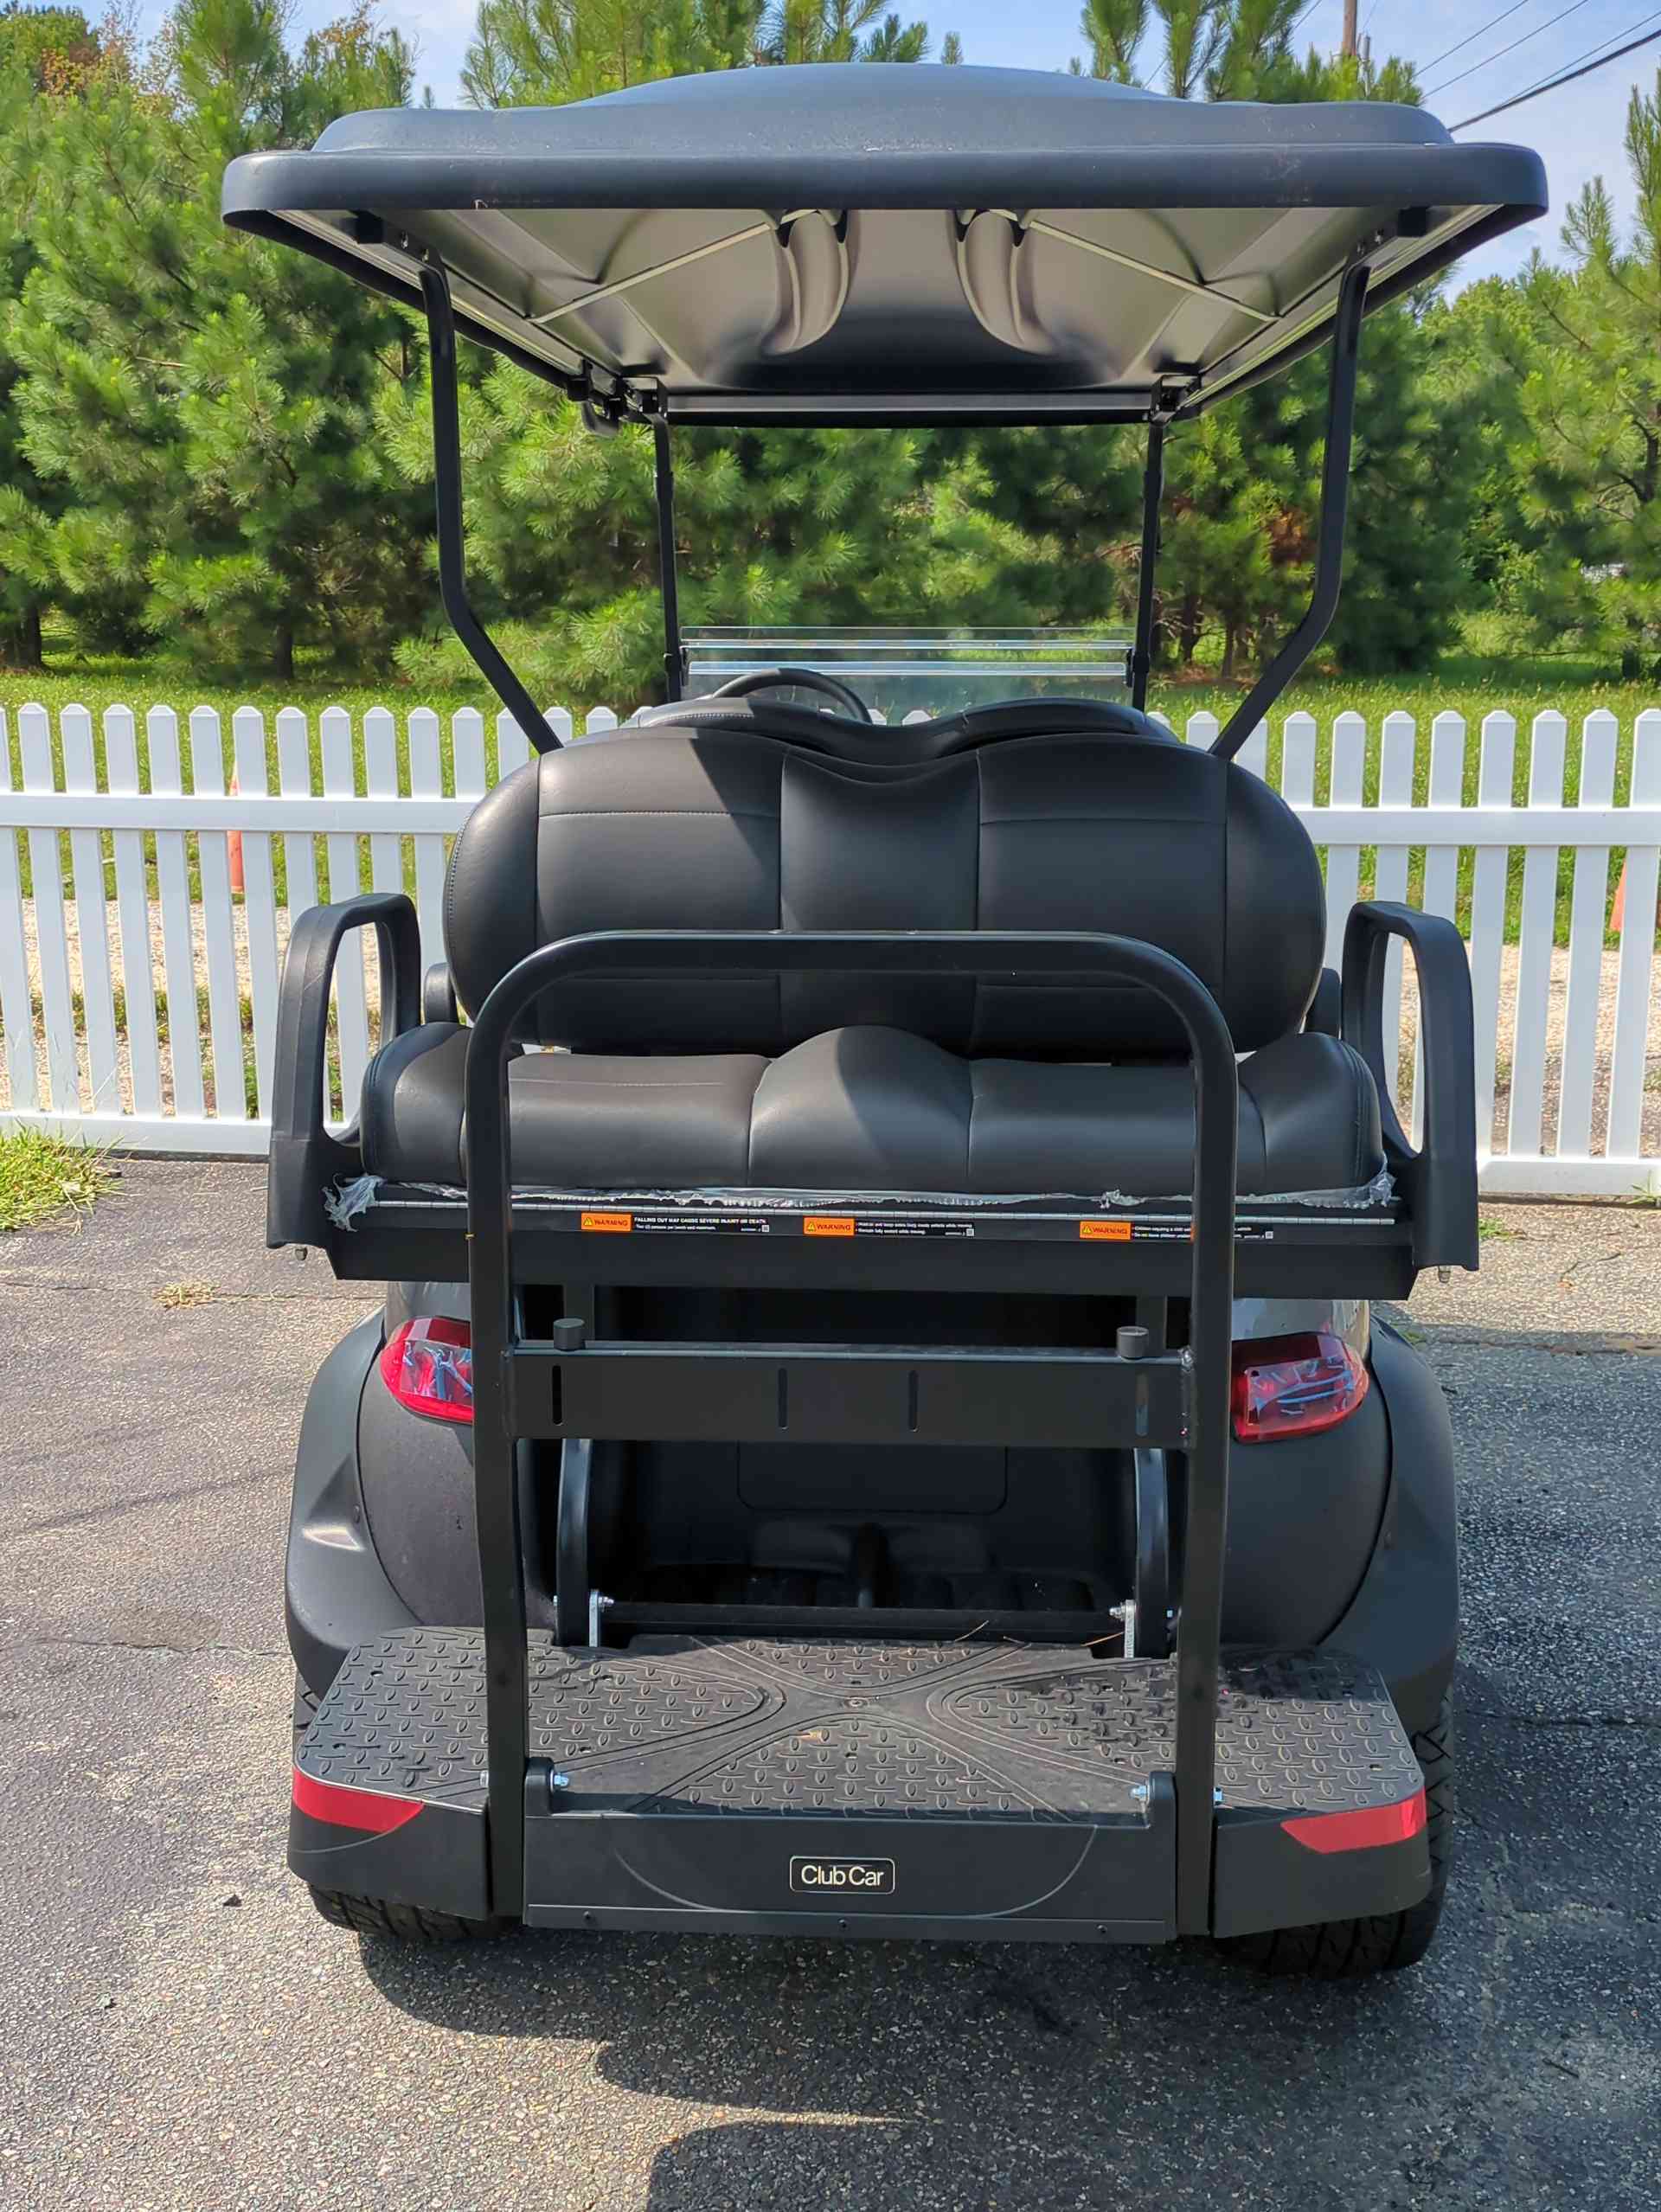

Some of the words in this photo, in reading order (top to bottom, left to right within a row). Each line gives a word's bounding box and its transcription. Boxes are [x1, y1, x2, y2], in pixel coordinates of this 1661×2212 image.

[1093, 1226, 1128, 1234] WARNING
[801, 1865, 847, 1886] Club
[848, 1866, 885, 1887] Car
